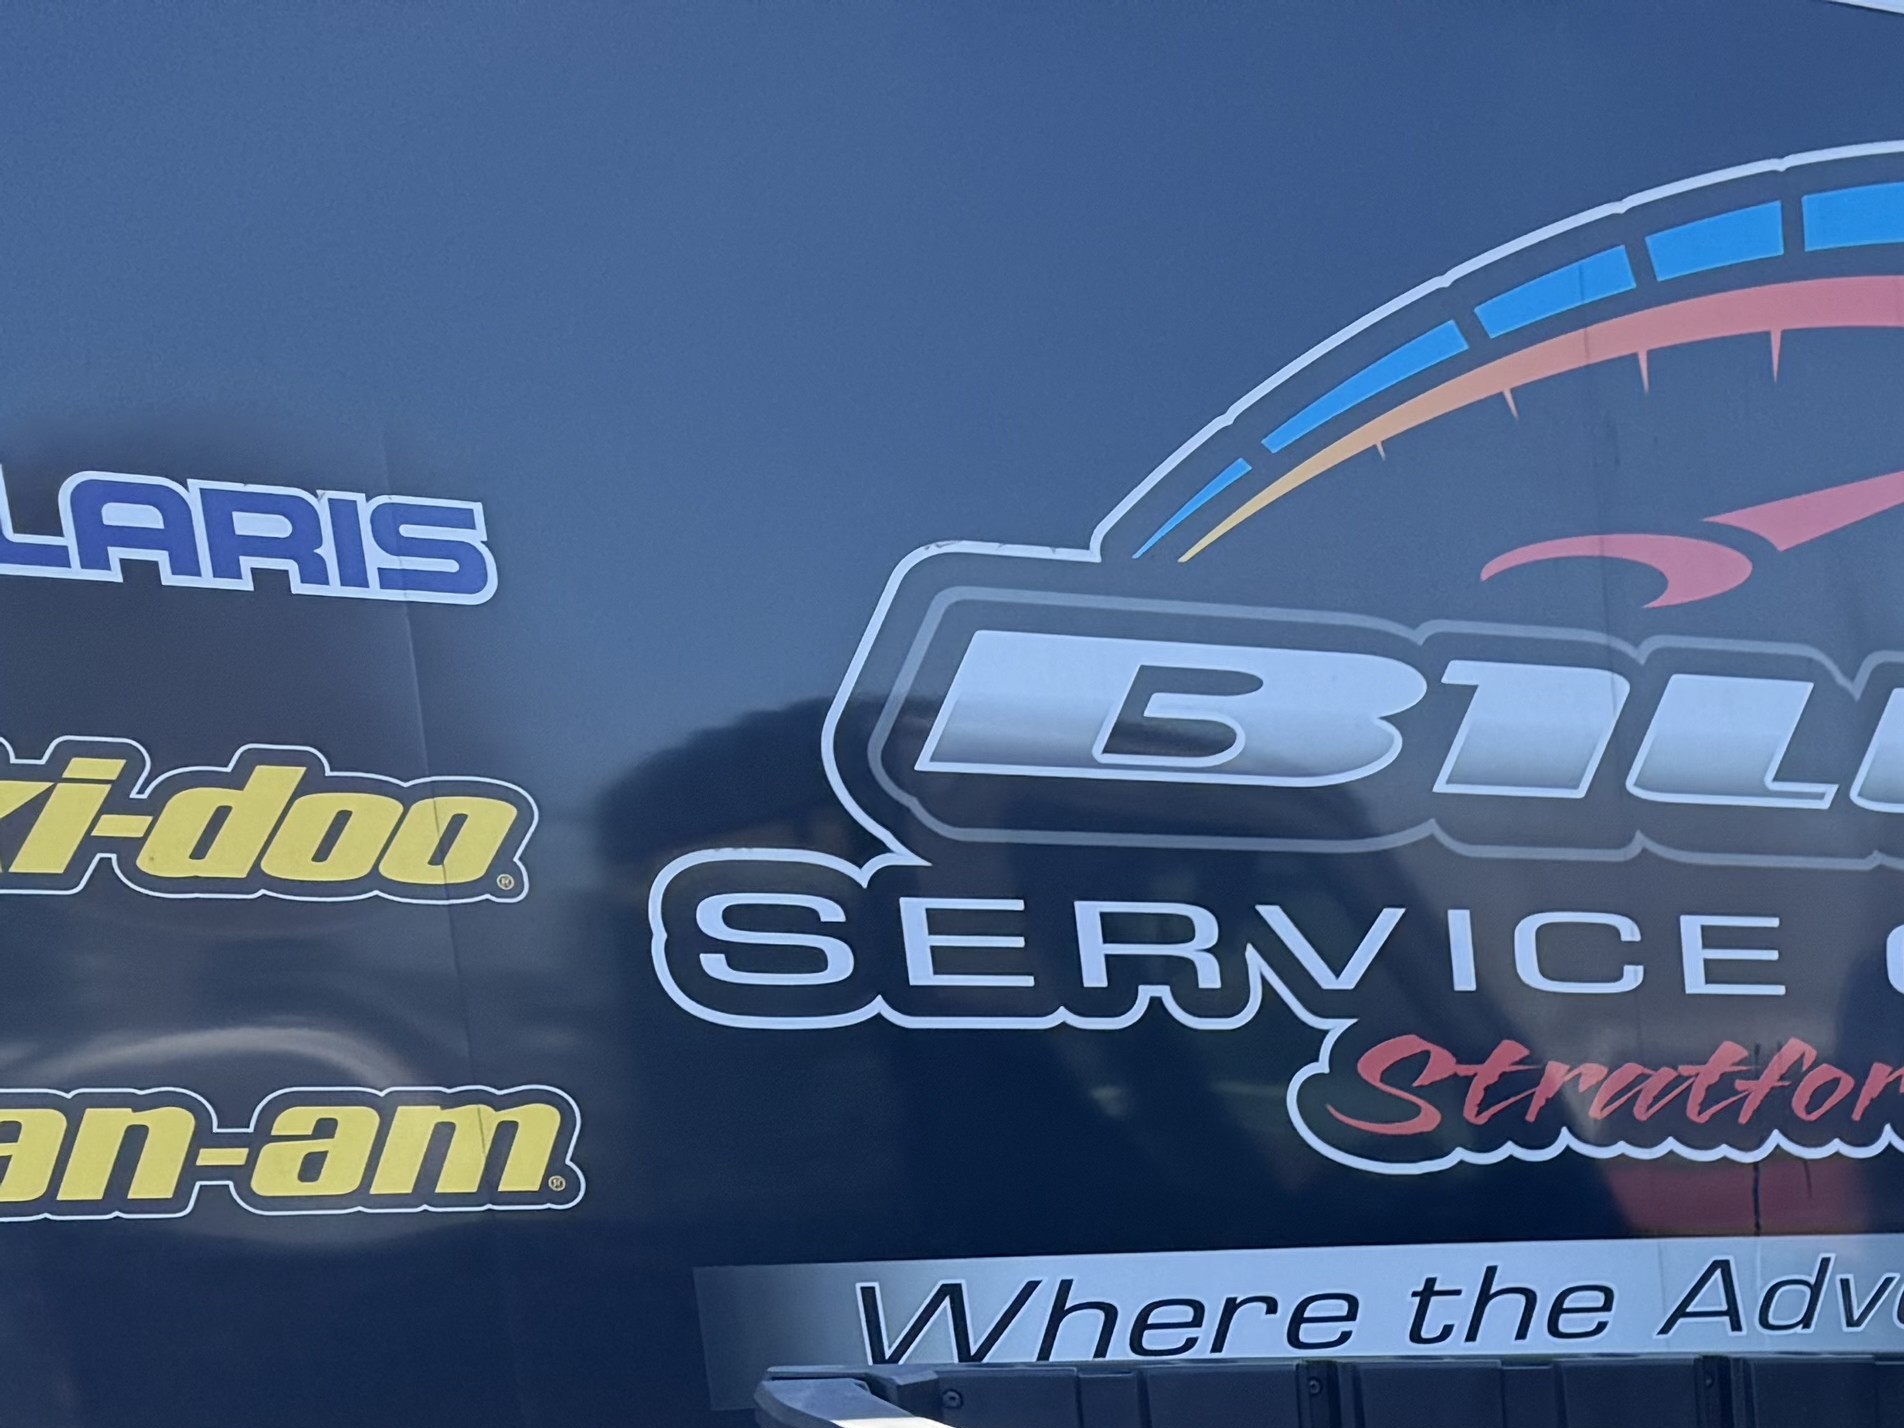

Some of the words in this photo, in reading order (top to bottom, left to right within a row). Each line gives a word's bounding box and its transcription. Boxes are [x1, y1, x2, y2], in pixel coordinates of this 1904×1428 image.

[692, 891, 1787, 998] SERVICE
[854, 1275, 1362, 1364] Where
[1404, 1264, 1614, 1346] the
